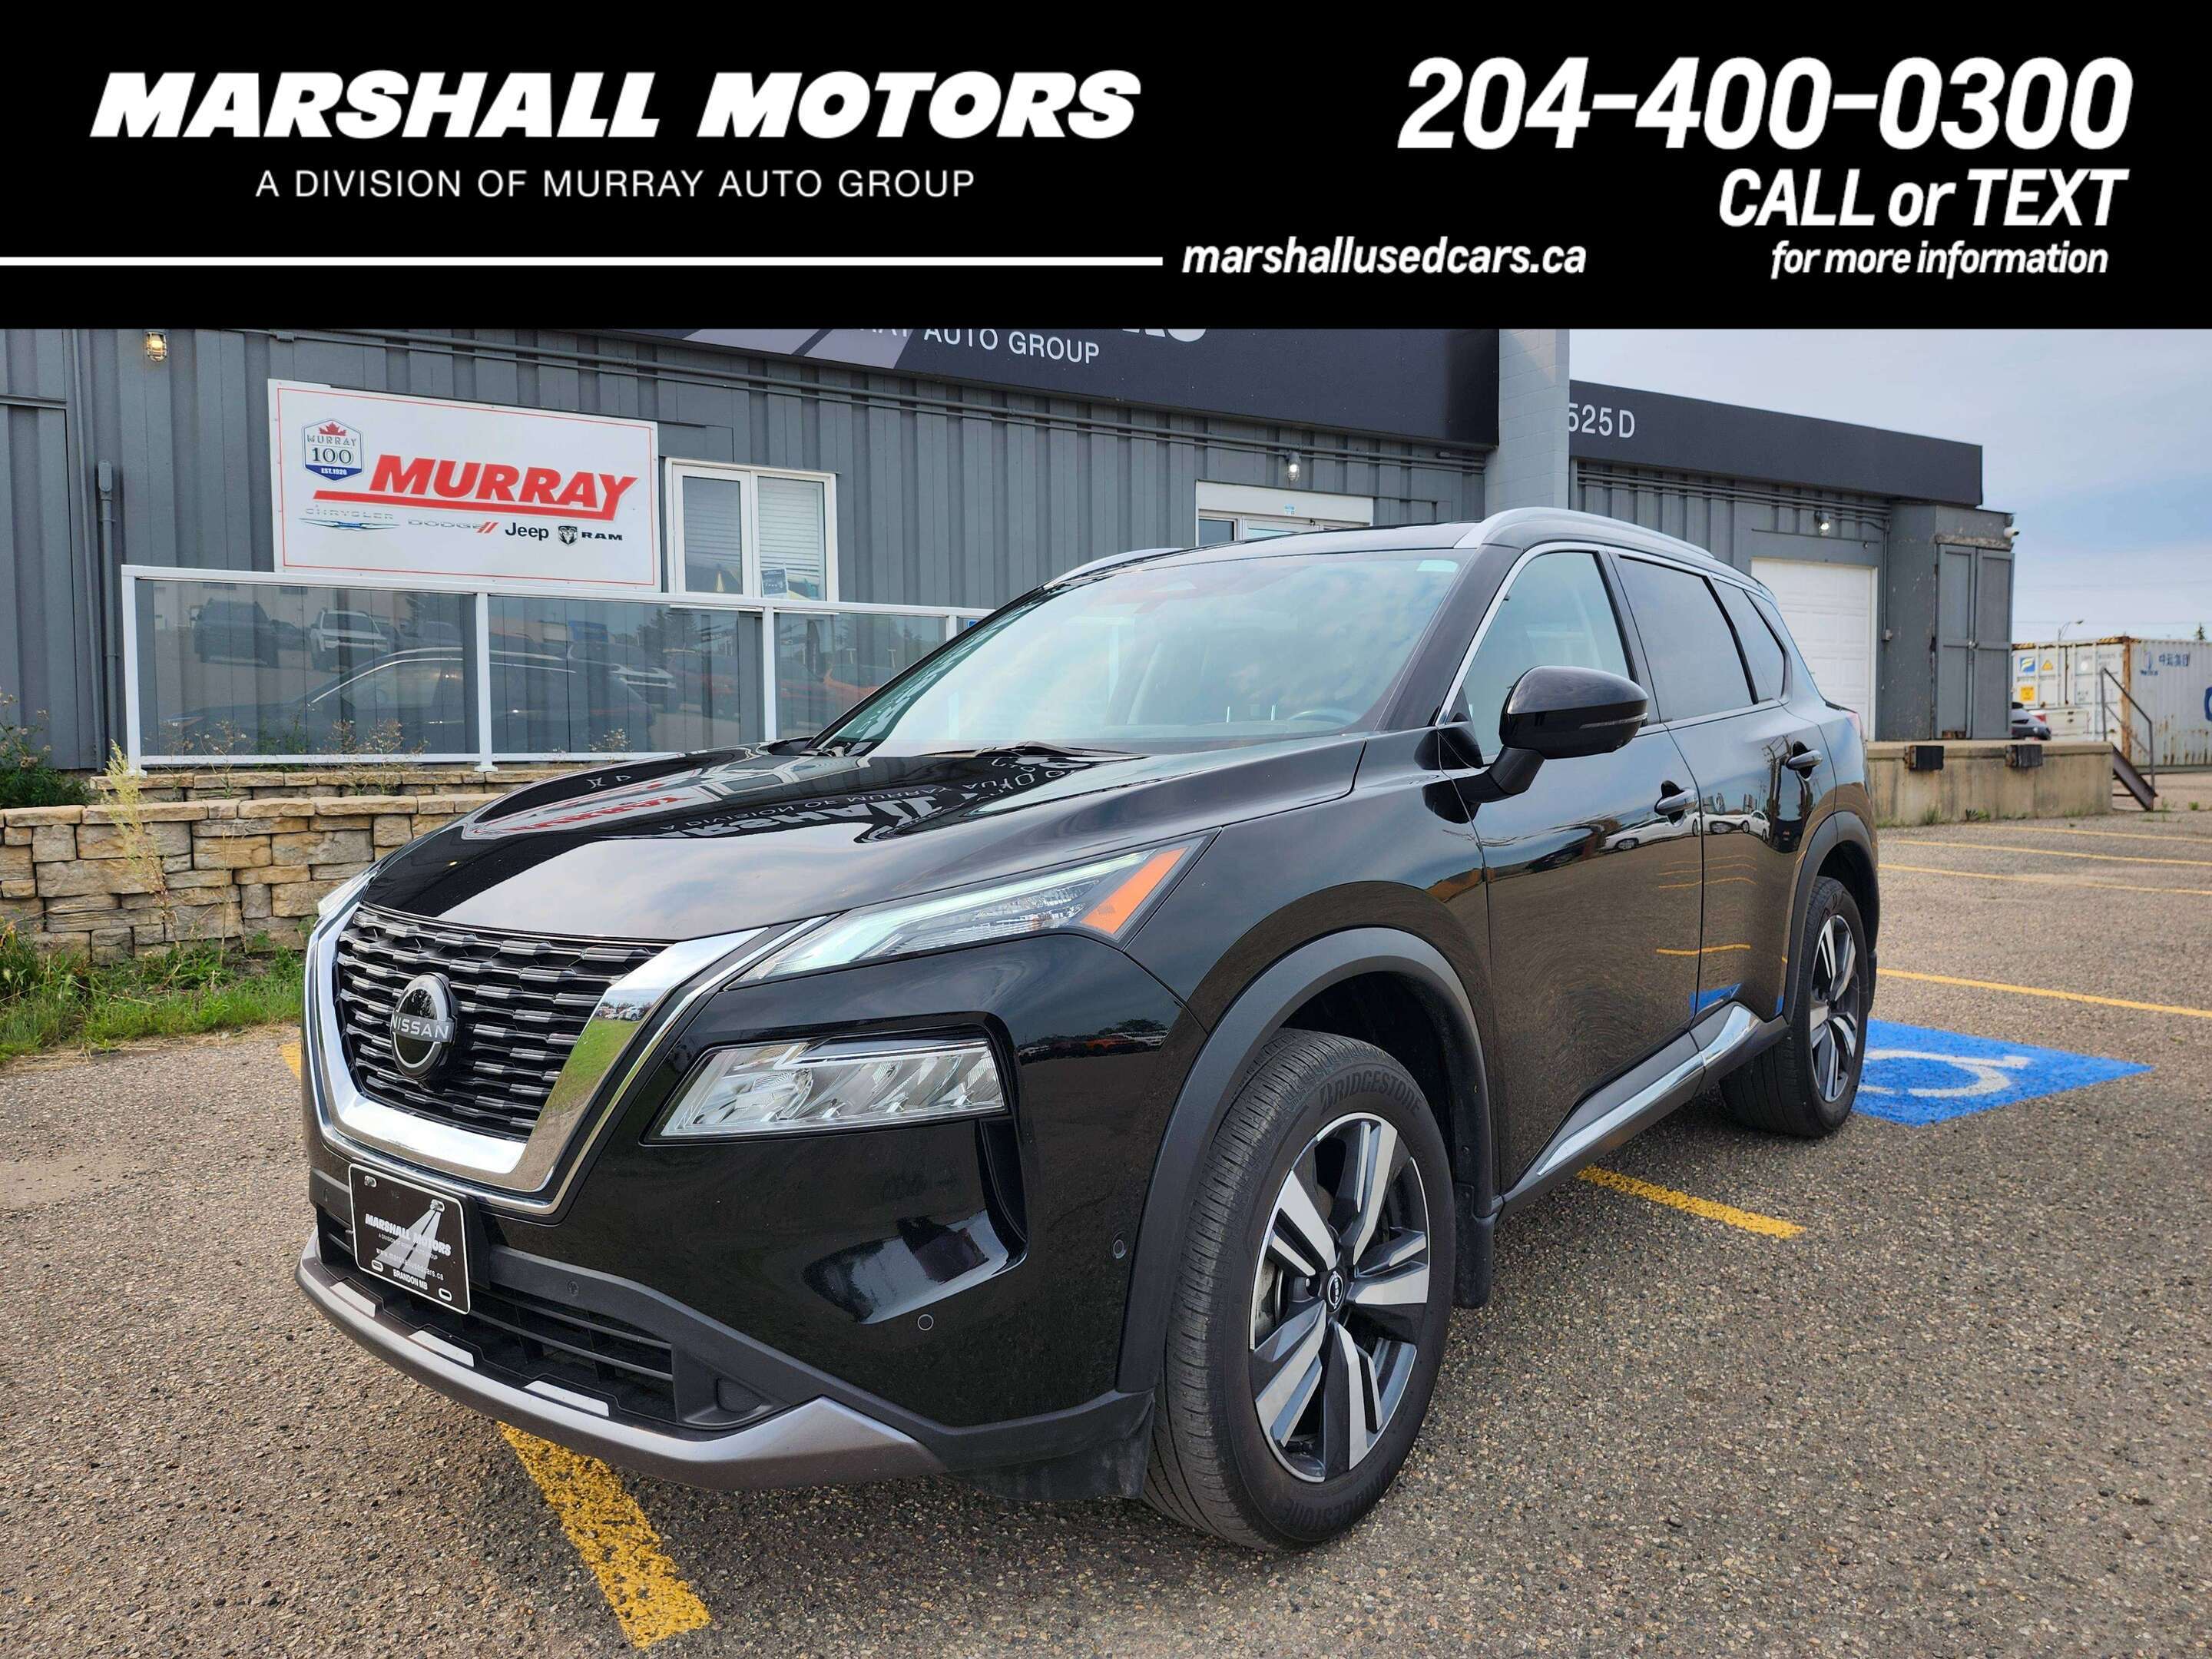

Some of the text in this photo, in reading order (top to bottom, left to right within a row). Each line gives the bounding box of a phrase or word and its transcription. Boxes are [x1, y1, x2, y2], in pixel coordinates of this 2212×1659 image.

[1008, 331, 1100, 364] GROUP
[1618, 409, 1635, 439] D
[306, 433, 356, 446] MURRAY
[312, 447, 353, 465] 100
[369, 453, 639, 520] MURRAY
[505, 522, 549, 541] Jeep
[581, 531, 623, 541] RAM
[391, 1013, 449, 1039] NISSAN
[1320, 1071, 1423, 1118] BRIDGESTONE
[365, 1213, 412, 1240] MARSHALL
[412, 1232, 452, 1257] MOTORS
[392, 1268, 429, 1290] BRANDON MB
